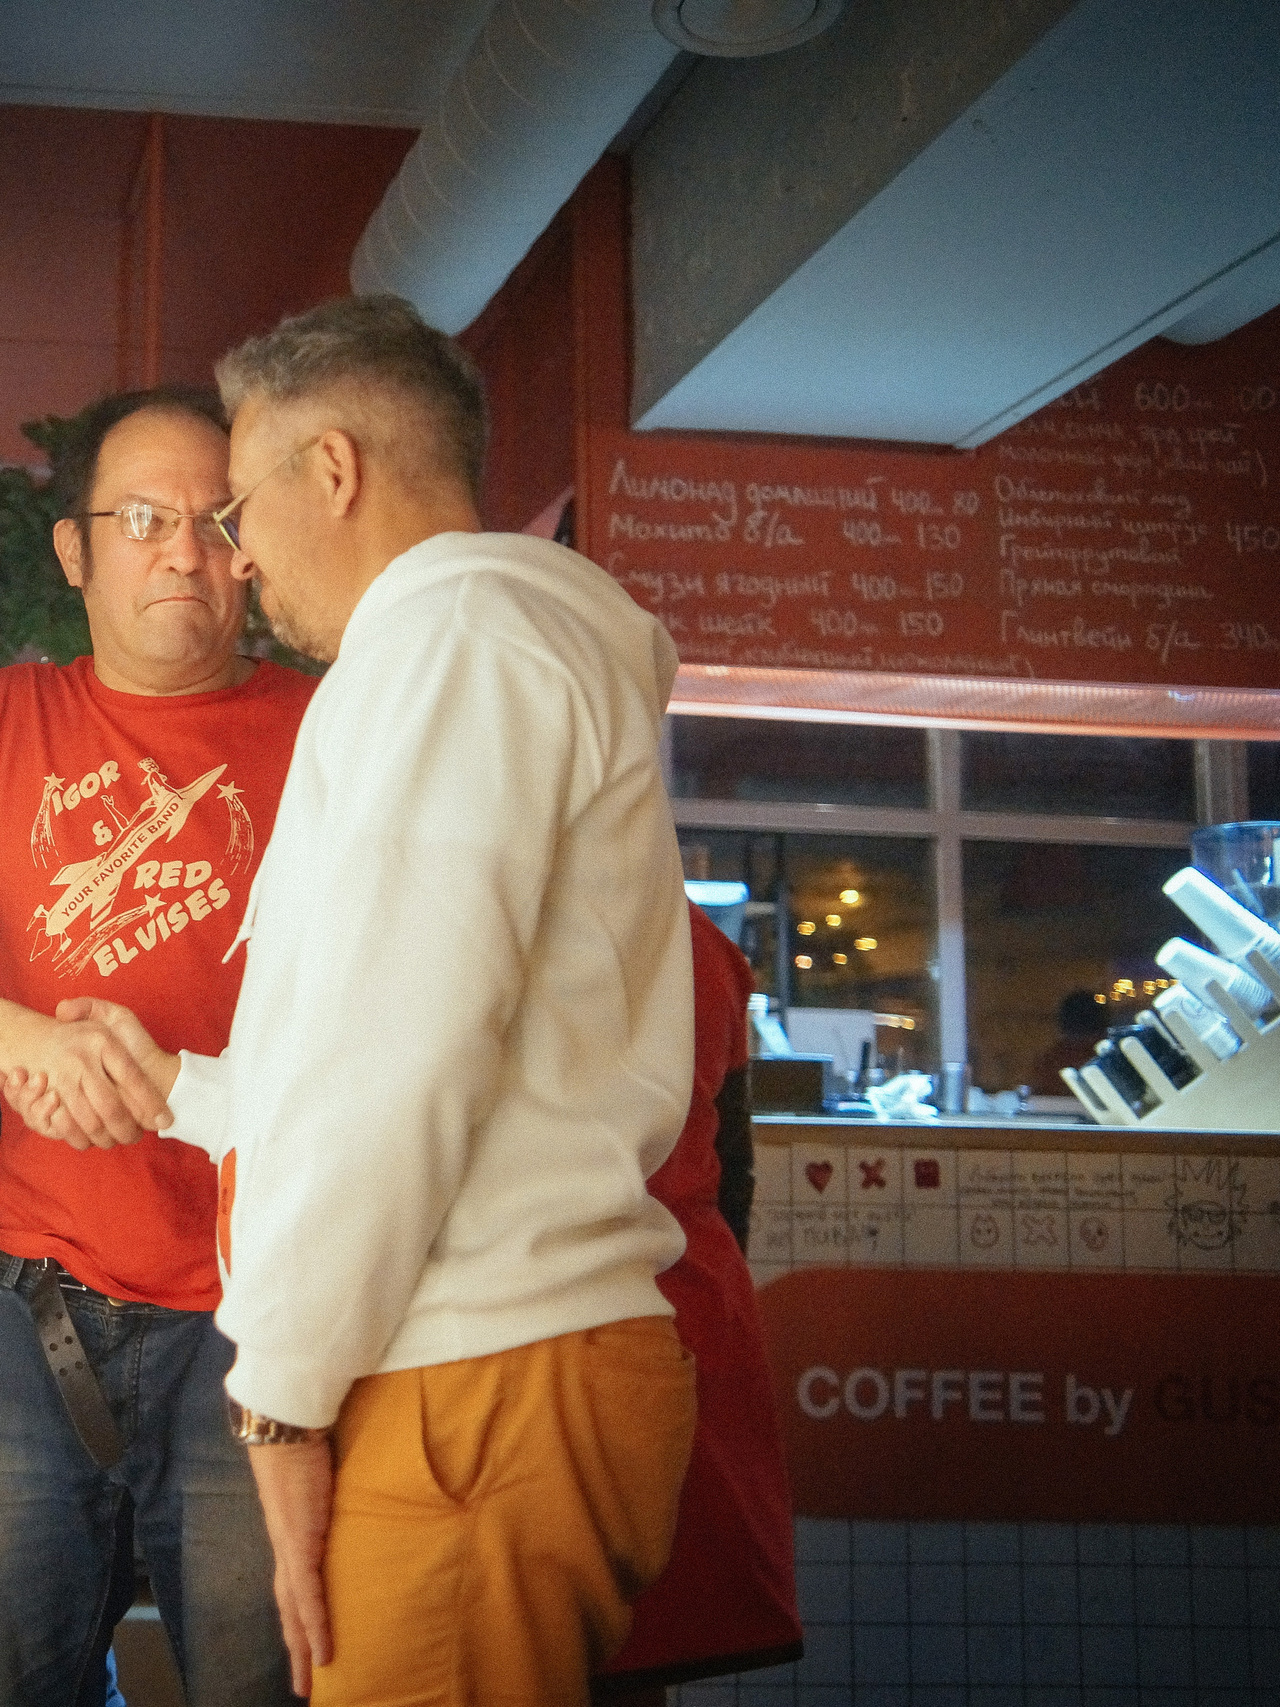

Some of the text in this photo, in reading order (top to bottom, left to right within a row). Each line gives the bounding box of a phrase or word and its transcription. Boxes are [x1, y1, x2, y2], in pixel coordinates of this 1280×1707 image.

[608, 458, 738, 527] Лимонад
[608, 510, 732, 543] Мохито
[698, 611, 778, 638] шейк
[51, 760, 122, 816] IGOR
[61, 801, 180, 918] YOUR FAVORITE BAND
[91, 819, 114, 846] &
[133, 860, 213, 890] RED
[92, 877, 232, 977] ELVISES
[796, 1365, 1046, 1425] COFFEE
[1065, 1373, 1135, 1436] by
